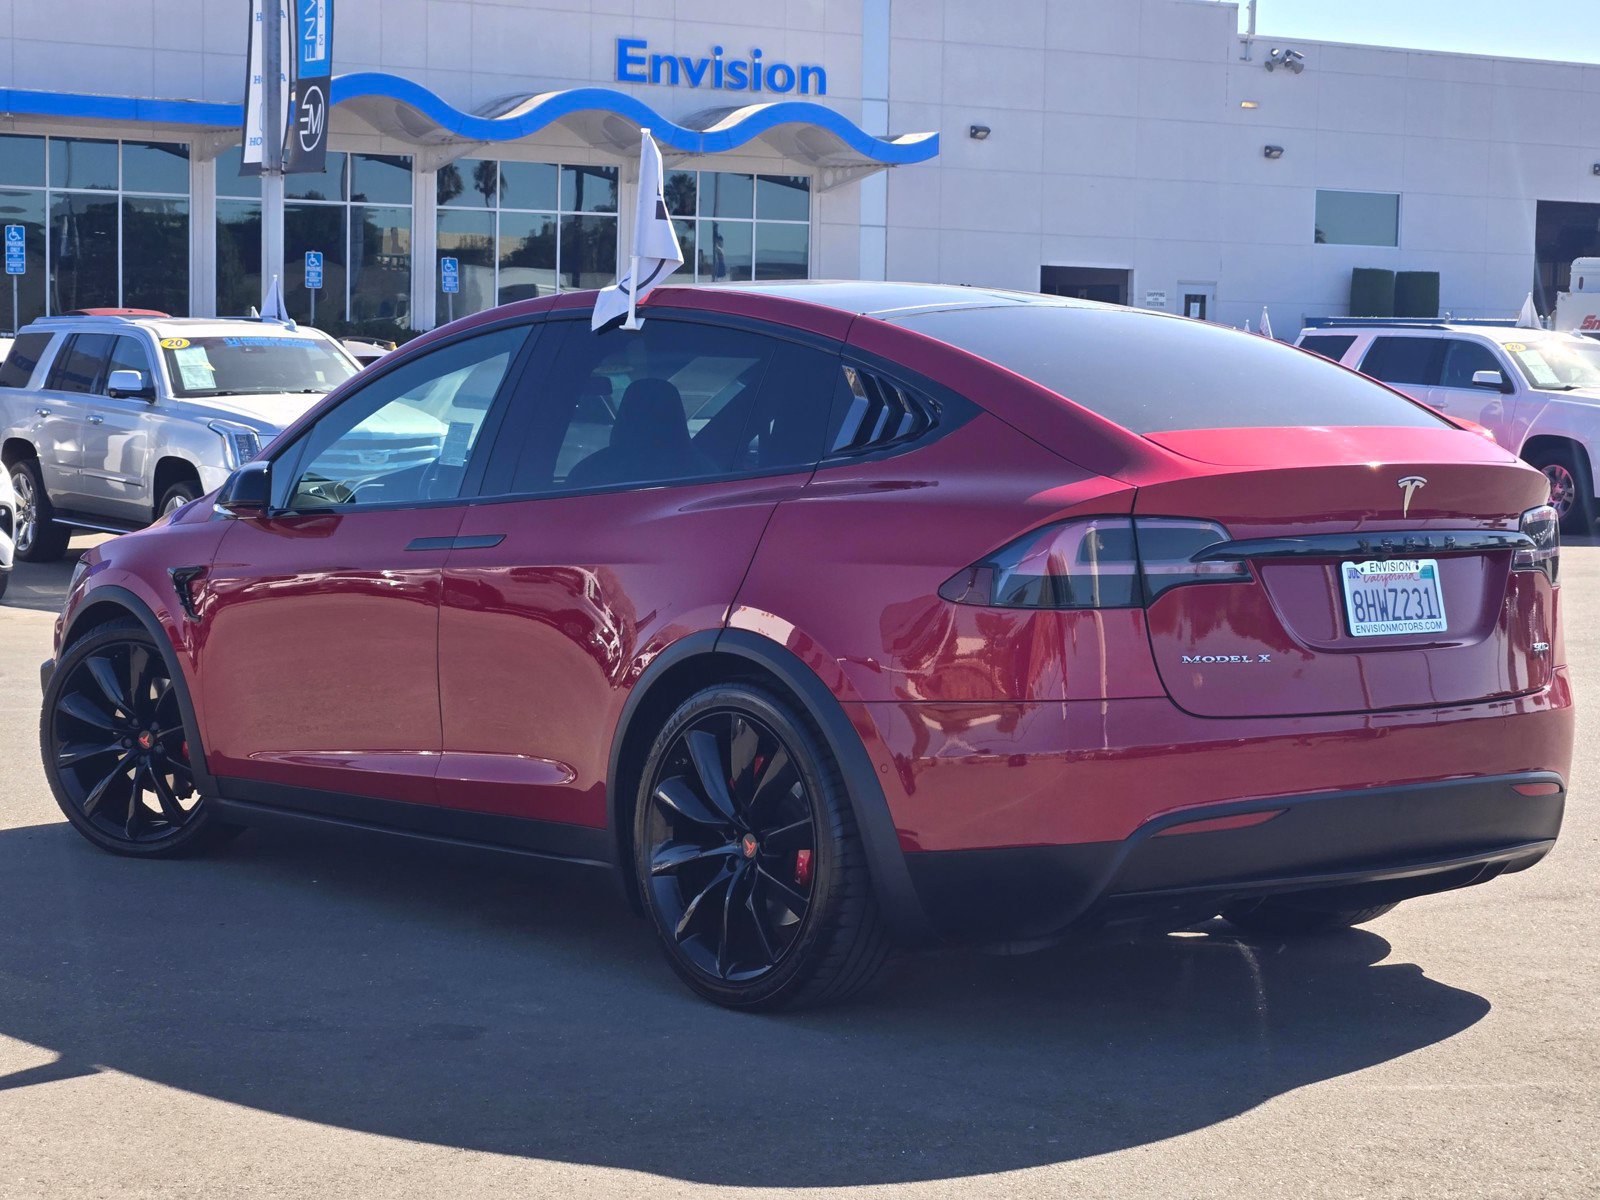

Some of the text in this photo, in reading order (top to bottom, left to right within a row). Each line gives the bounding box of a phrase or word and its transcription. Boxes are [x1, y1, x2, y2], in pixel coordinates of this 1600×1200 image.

[616, 37, 827, 95] Envision
[167, 339, 183, 347] 20
[1369, 561, 1411, 573] ENVISION
[1353, 588, 1436, 622] 8HWZ231
[1355, 620, 1443, 634] ENVISIONMOTORS.COM
[1181, 654, 1272, 664] MODEL X
